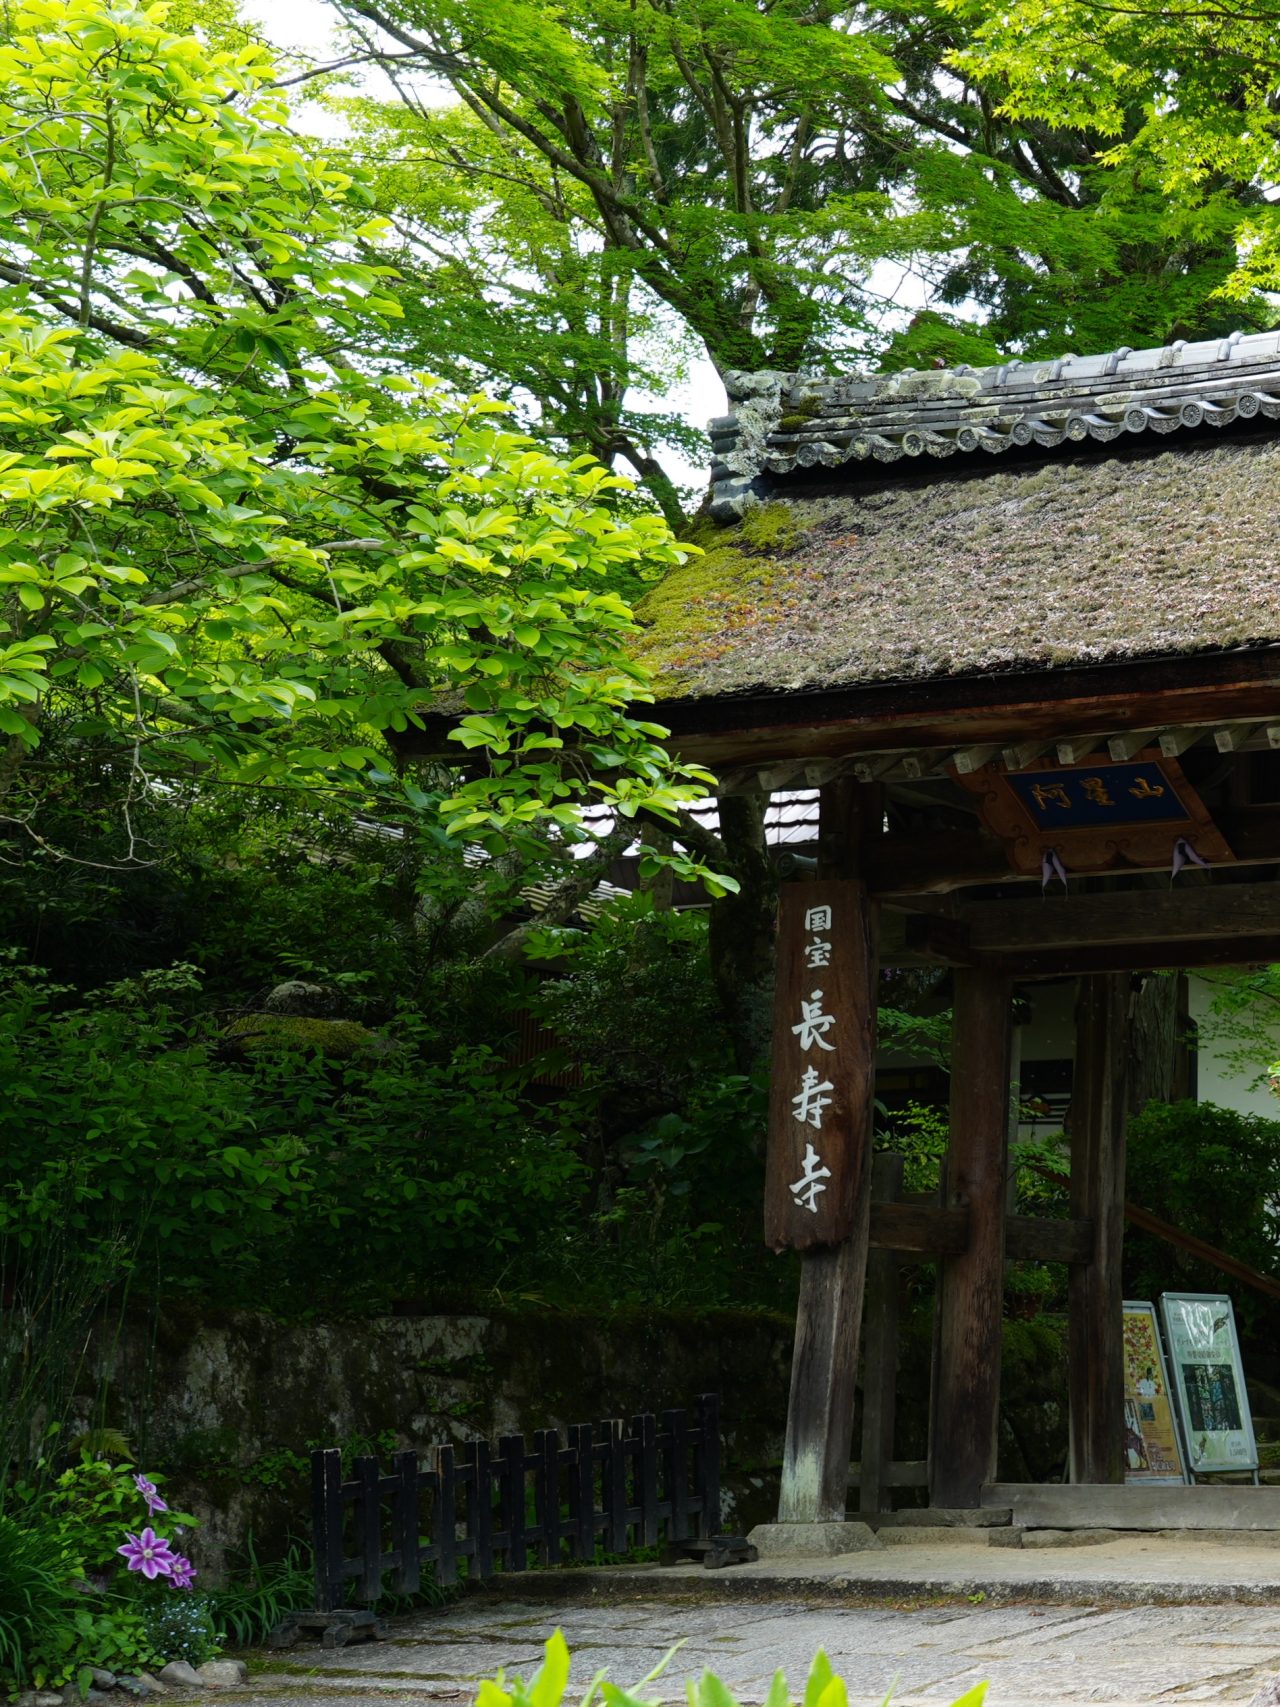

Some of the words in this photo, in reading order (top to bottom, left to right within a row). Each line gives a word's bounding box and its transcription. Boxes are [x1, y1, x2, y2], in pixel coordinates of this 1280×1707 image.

[804, 904, 833, 969] 国宝
[789, 989, 837, 1214] 長寿寺
